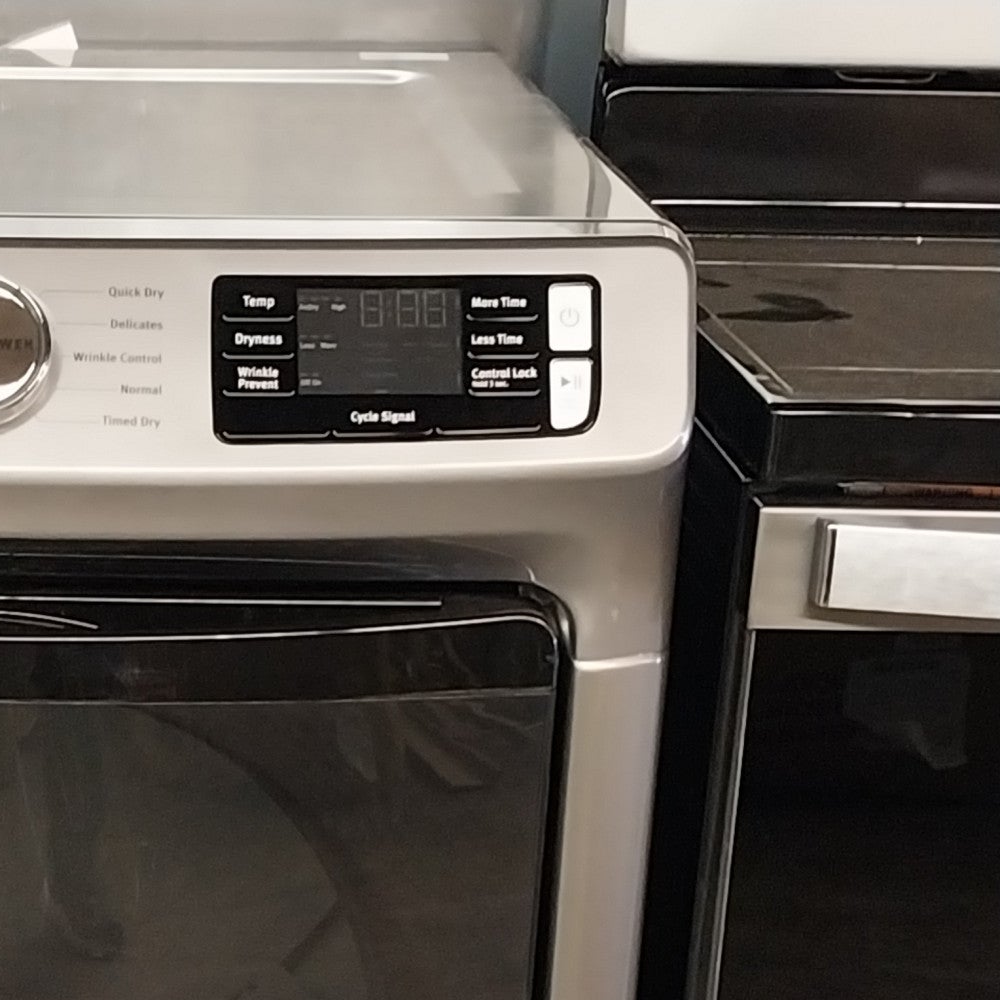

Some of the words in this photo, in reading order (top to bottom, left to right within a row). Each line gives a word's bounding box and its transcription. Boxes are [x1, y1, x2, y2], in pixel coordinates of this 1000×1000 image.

[108, 287, 140, 298] Quick
[144, 287, 165, 299] Dry
[242, 294, 276, 310] Temp
[471, 297, 499, 308] More
[501, 296, 527, 308] Time
[110, 319, 163, 330] Delicates
[234, 332, 283, 348] Dryness
[471, 334, 496, 346] Less
[498, 333, 524, 345] Time
[73, 352, 117, 363] Wrinkle
[120, 352, 162, 364] Control
[237, 366, 279, 378] Wrinkle
[471, 368, 510, 380] Control
[512, 366, 538, 379] Lock
[121, 384, 162, 395] Normal
[237, 378, 279, 390] Prevent
[103, 415, 138, 427] Timed
[141, 416, 161, 429] Dry
[350, 411, 379, 425] Cycle
[381, 410, 416, 424] Signal
